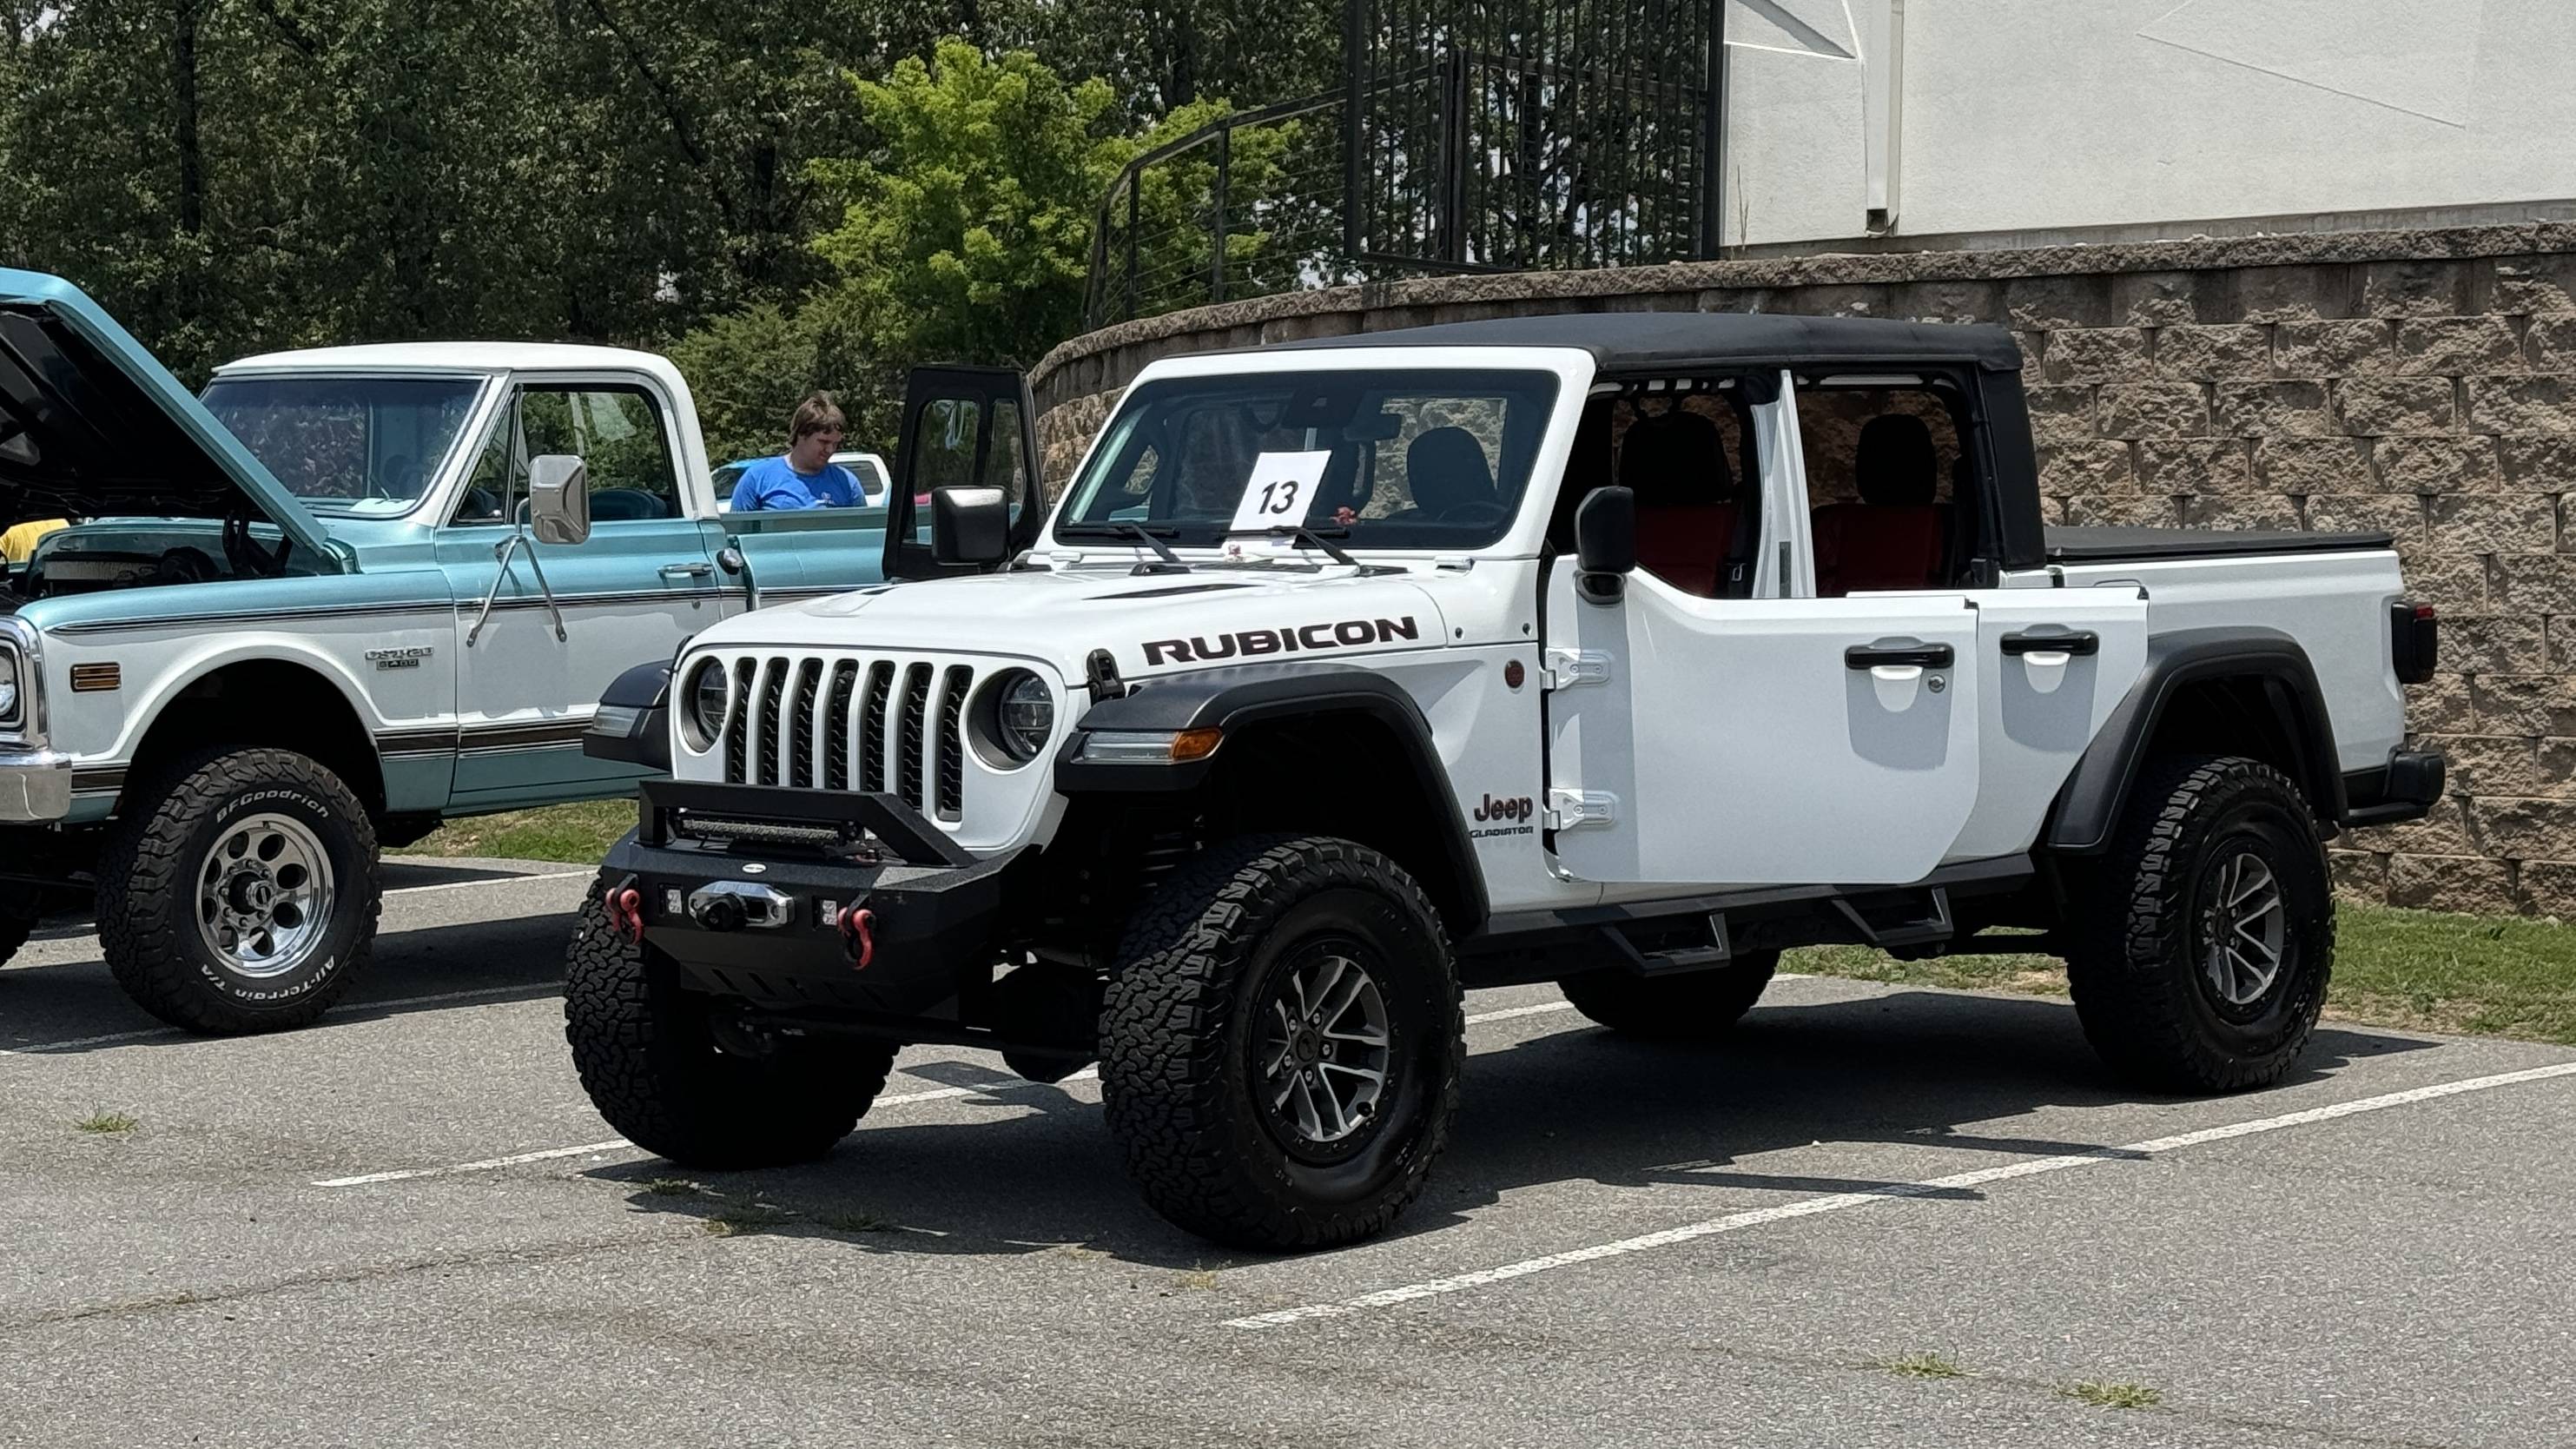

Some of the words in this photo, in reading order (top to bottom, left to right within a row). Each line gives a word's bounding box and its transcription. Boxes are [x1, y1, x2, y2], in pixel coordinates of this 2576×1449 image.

[1258, 480, 1299, 514] 13
[1141, 616, 1419, 666] RUBICON
[216, 789, 329, 824] BFGoodrich
[1474, 793, 1533, 824] Jeep
[1470, 826, 1534, 838] GLADIATOR
[201, 964, 227, 990] T/A
[234, 956, 334, 1001] All-Terrain
